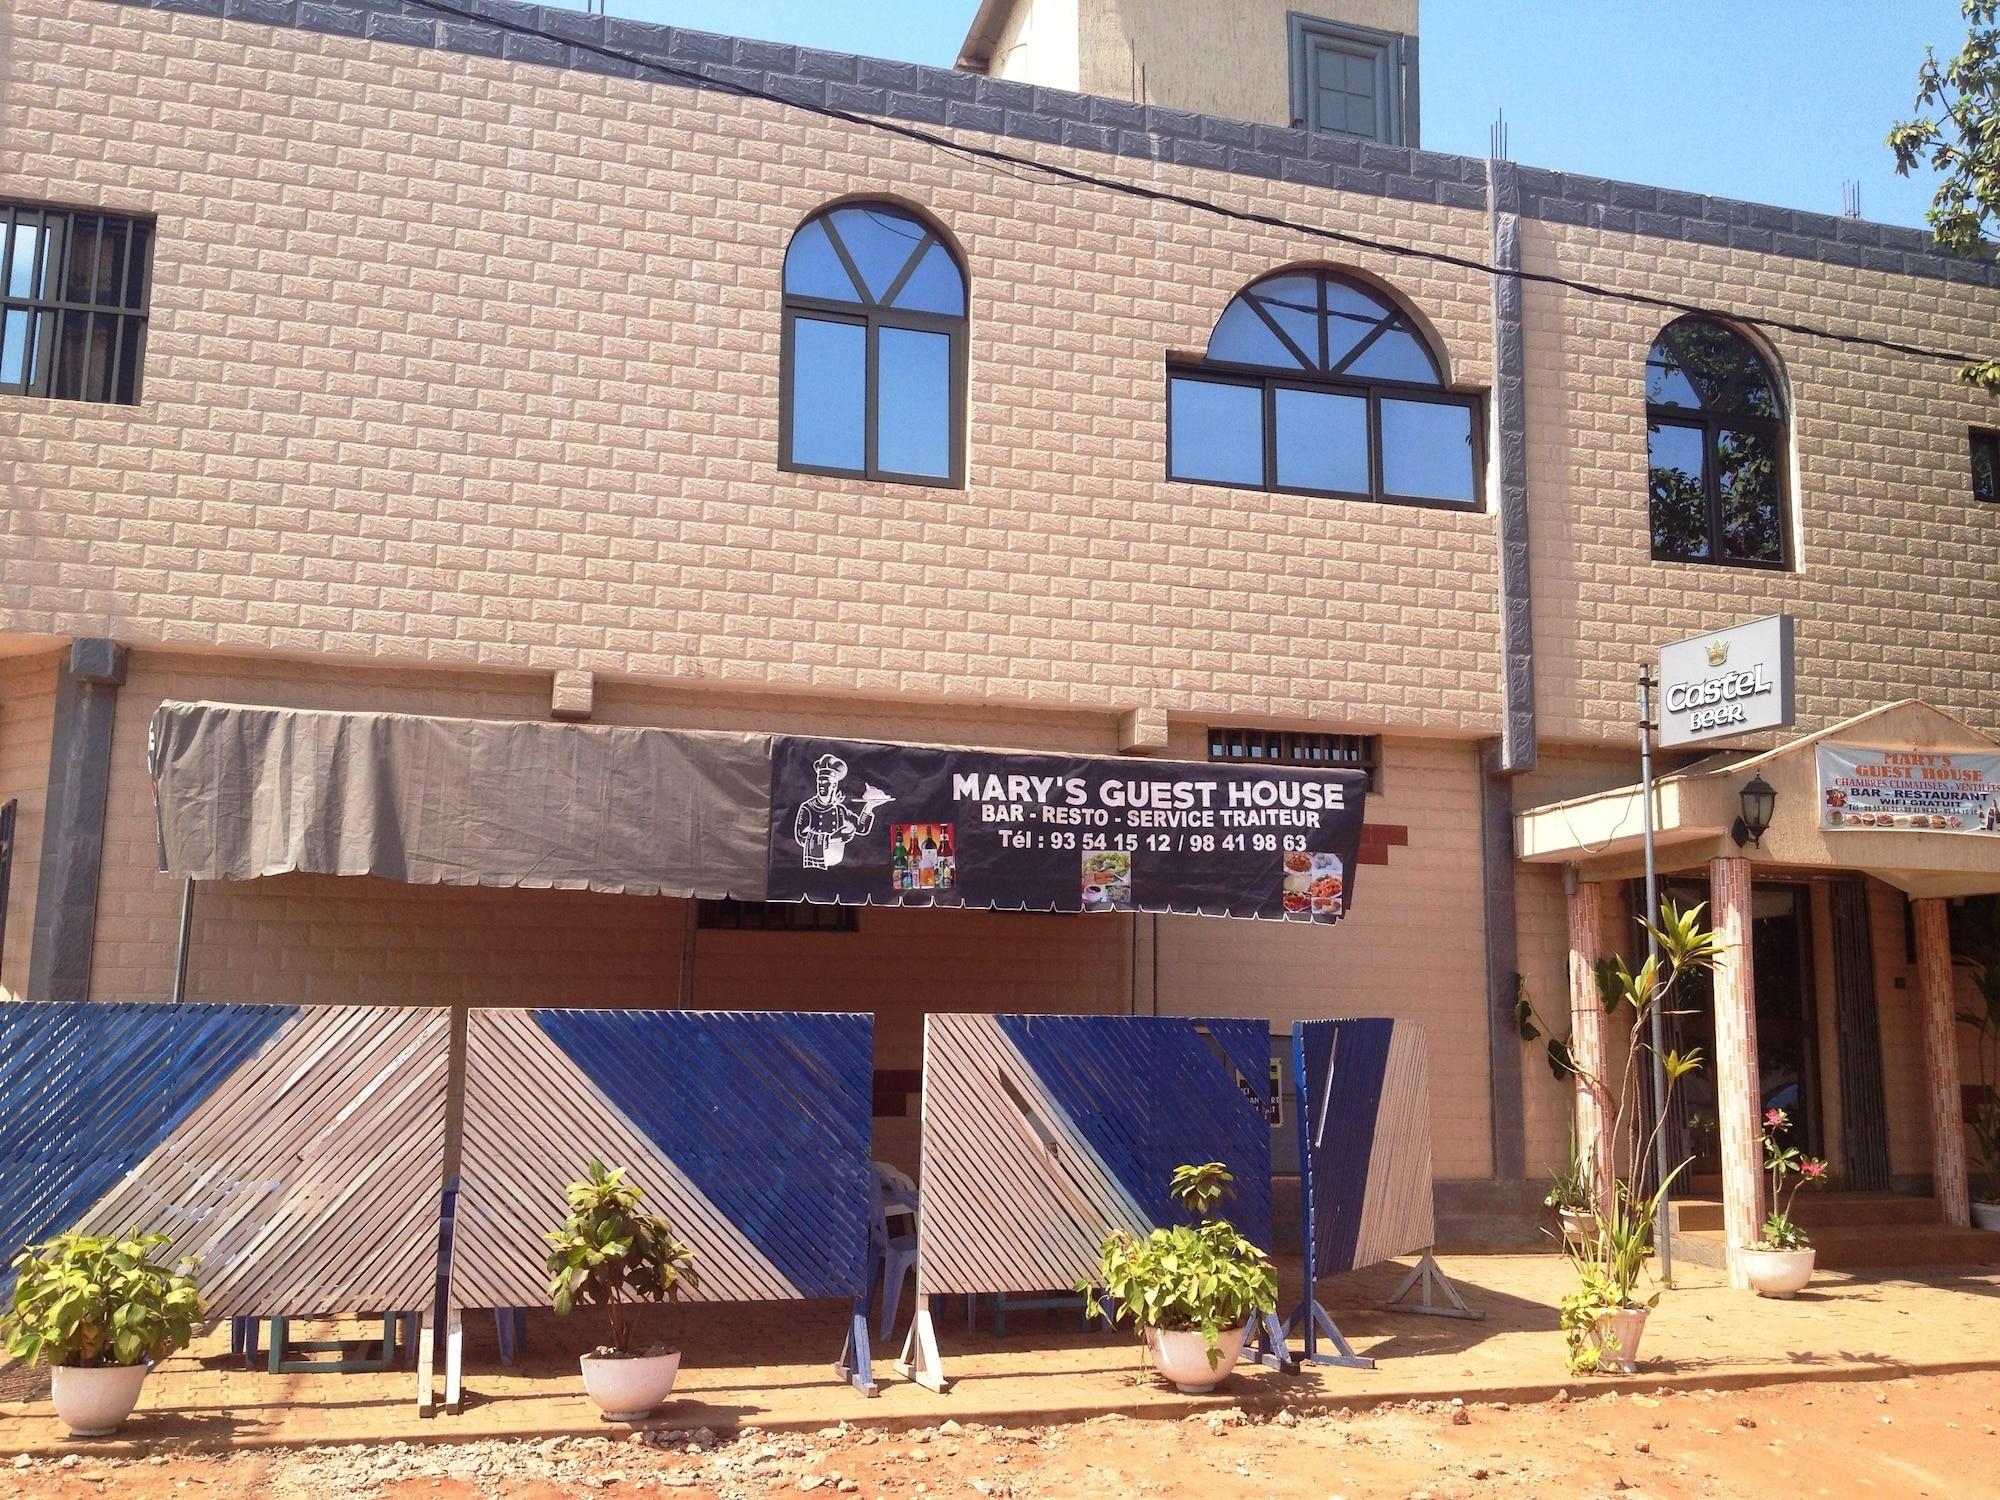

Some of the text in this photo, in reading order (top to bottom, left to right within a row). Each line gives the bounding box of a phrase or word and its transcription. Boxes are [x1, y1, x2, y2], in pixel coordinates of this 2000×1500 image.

[1884, 753, 1952, 767] MARY'S
[1855, 764, 1983, 782] GUEST HOUSE
[1835, 778, 1888, 788] CHAMBRES
[952, 773, 1345, 810] MARY'S GUEST HOUSE
[1850, 788, 1881, 797] BAR
[1894, 789, 1989, 801] RESTAURANT
[1910, 800, 1961, 808] GRATUIT
[981, 804, 1025, 823] BAR
[1042, 805, 1109, 826] RESTO
[1126, 810, 1214, 828] SERVICE
[1220, 809, 1321, 829] TRAITEUR
[998, 829, 1031, 849] Tél
[1050, 832, 1076, 850] 93
[1082, 832, 1107, 850] 54
[1113, 833, 1138, 852] 15
[1146, 834, 1171, 852] 12
[1189, 834, 1215, 852] 98
[1221, 834, 1245, 851] 41
[1252, 833, 1277, 852] 98
[1283, 834, 1307, 852] 63
